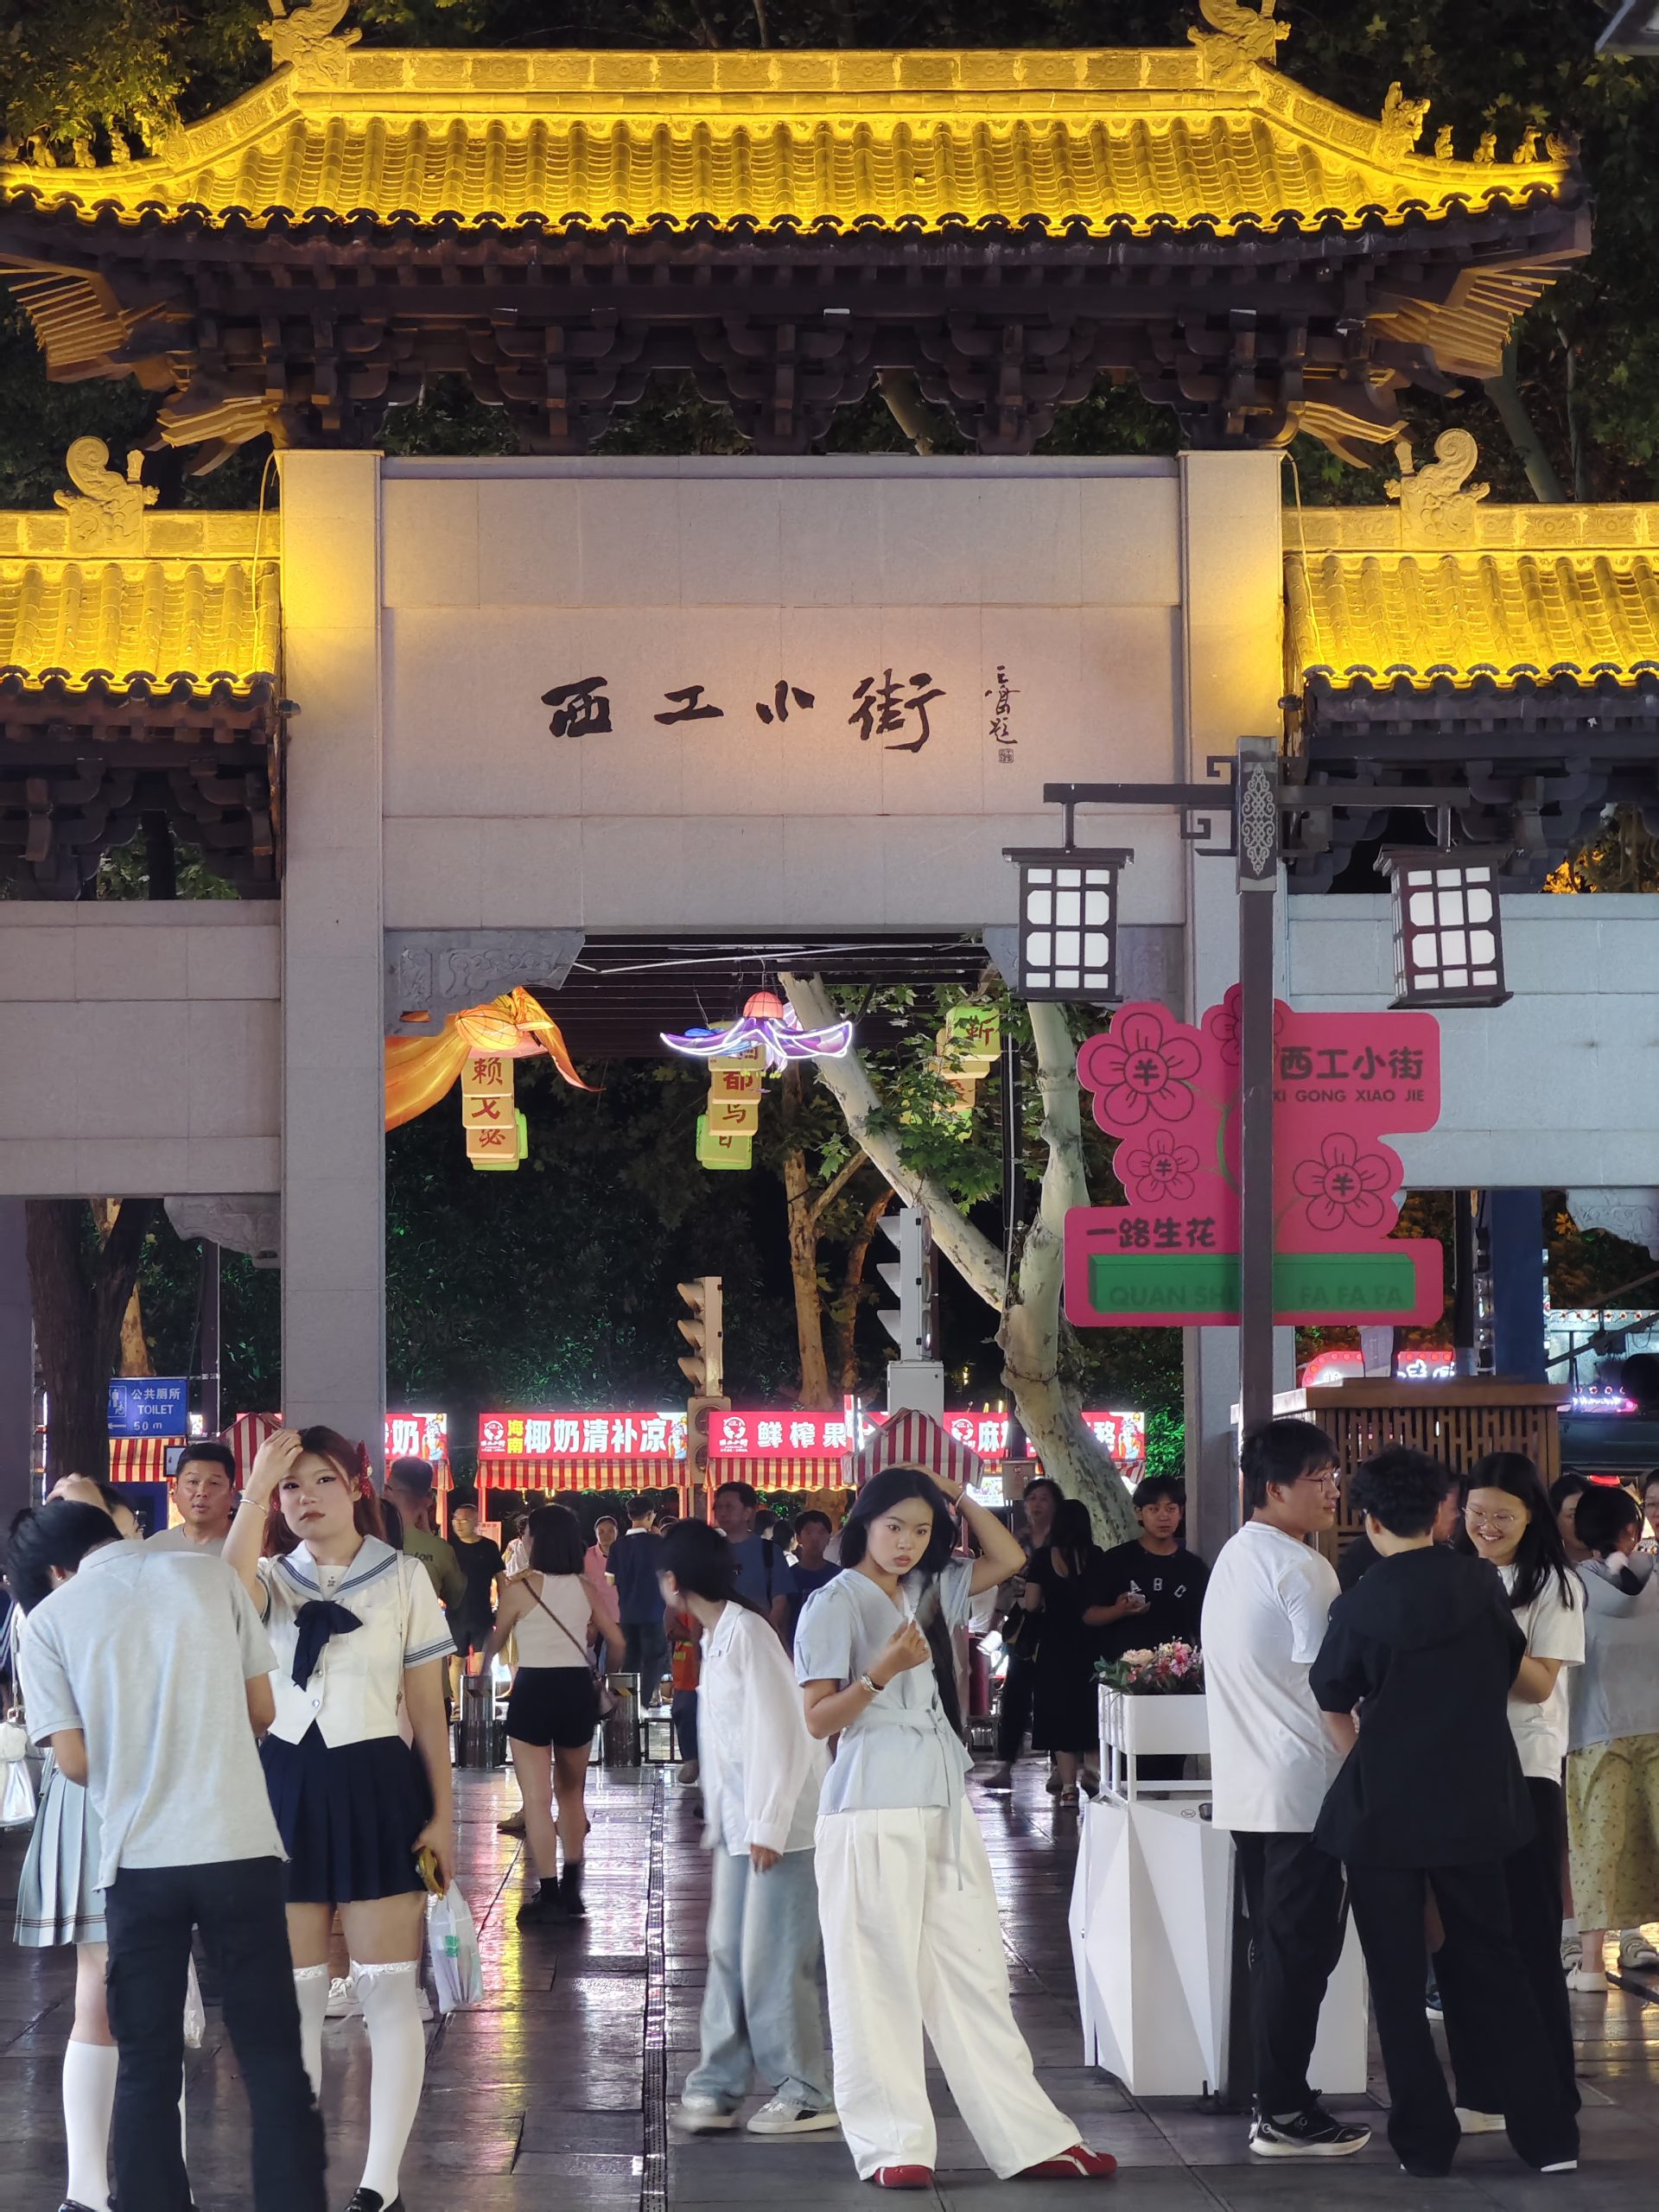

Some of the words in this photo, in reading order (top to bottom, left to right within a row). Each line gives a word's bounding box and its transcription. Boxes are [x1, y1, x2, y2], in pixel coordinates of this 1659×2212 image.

[540, 668, 947, 753] 西工小街
[1281, 1045, 1424, 1080] 西工小街
[1295, 1089, 1347, 1103] GONG
[1355, 1089, 1396, 1103] XIAO
[1404, 1089, 1425, 1103] JIE
[1086, 1217, 1217, 1248] 一路生花
[1109, 1286, 1187, 1306] QUAN
[1299, 1285, 1329, 1306] FA
[1337, 1285, 1367, 1306] FA
[1375, 1285, 1403, 1306] FA
[130, 1388, 181, 1401] 公共厕所
[137, 1404, 175, 1414] TOILET
[133, 1421, 149, 1431] 50
[507, 1419, 524, 1454] 海南
[524, 1418, 667, 1454] 椰奶清补凉
[757, 1421, 876, 1449] 鲜榨果
